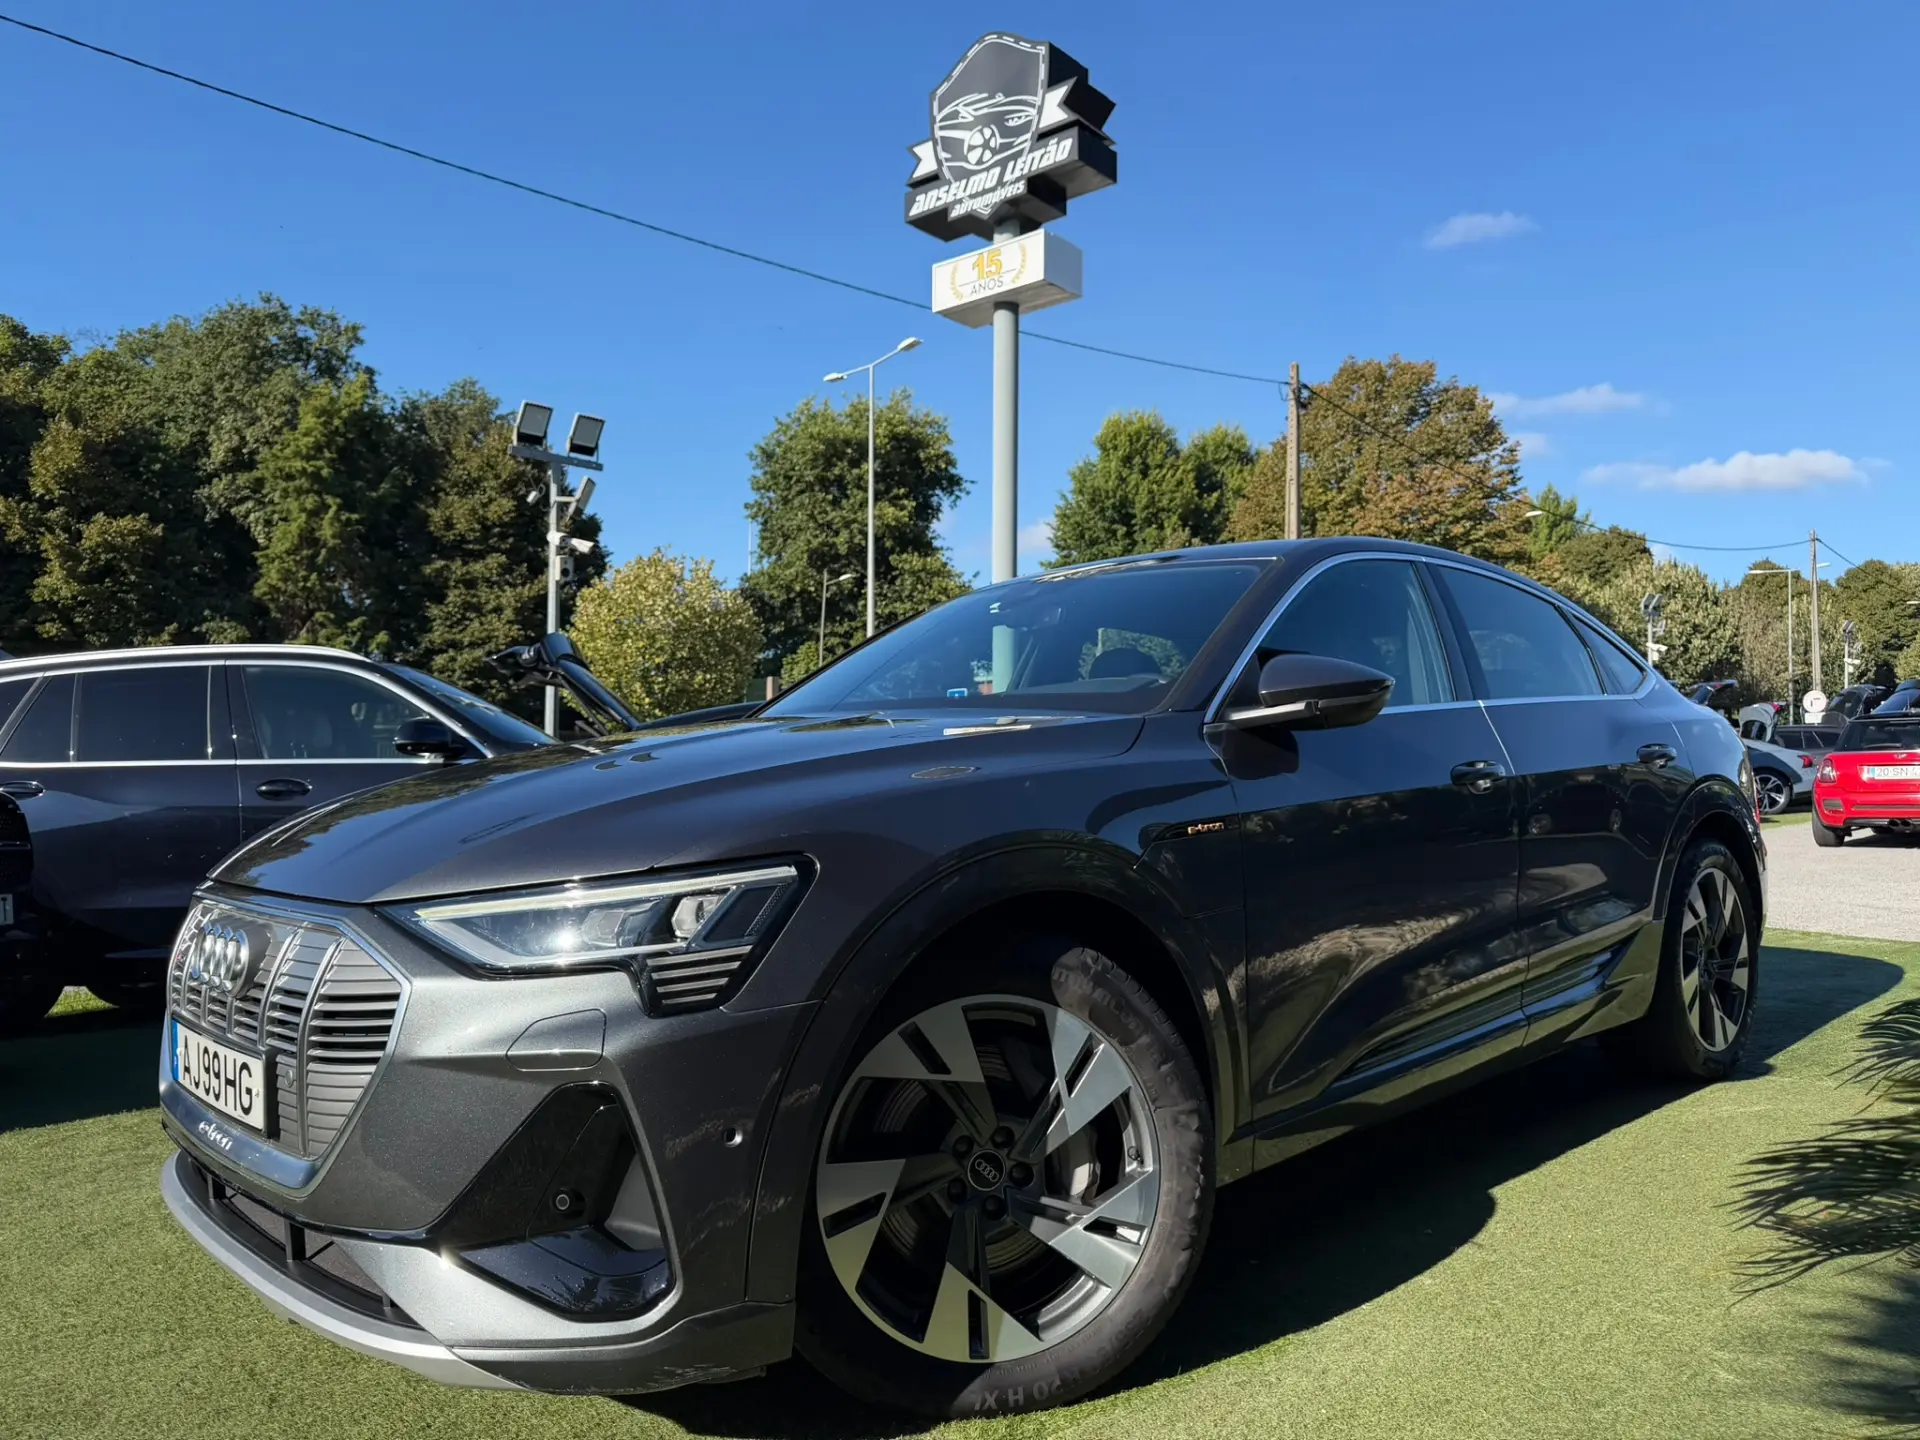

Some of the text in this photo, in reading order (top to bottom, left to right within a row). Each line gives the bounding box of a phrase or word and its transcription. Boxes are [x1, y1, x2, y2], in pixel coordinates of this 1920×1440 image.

[909, 167, 1001, 216] ANSELMO
[972, 248, 1003, 280] 15
[969, 276, 1004, 296] ANOS
[183, 1034, 253, 1116] AJ99HG
